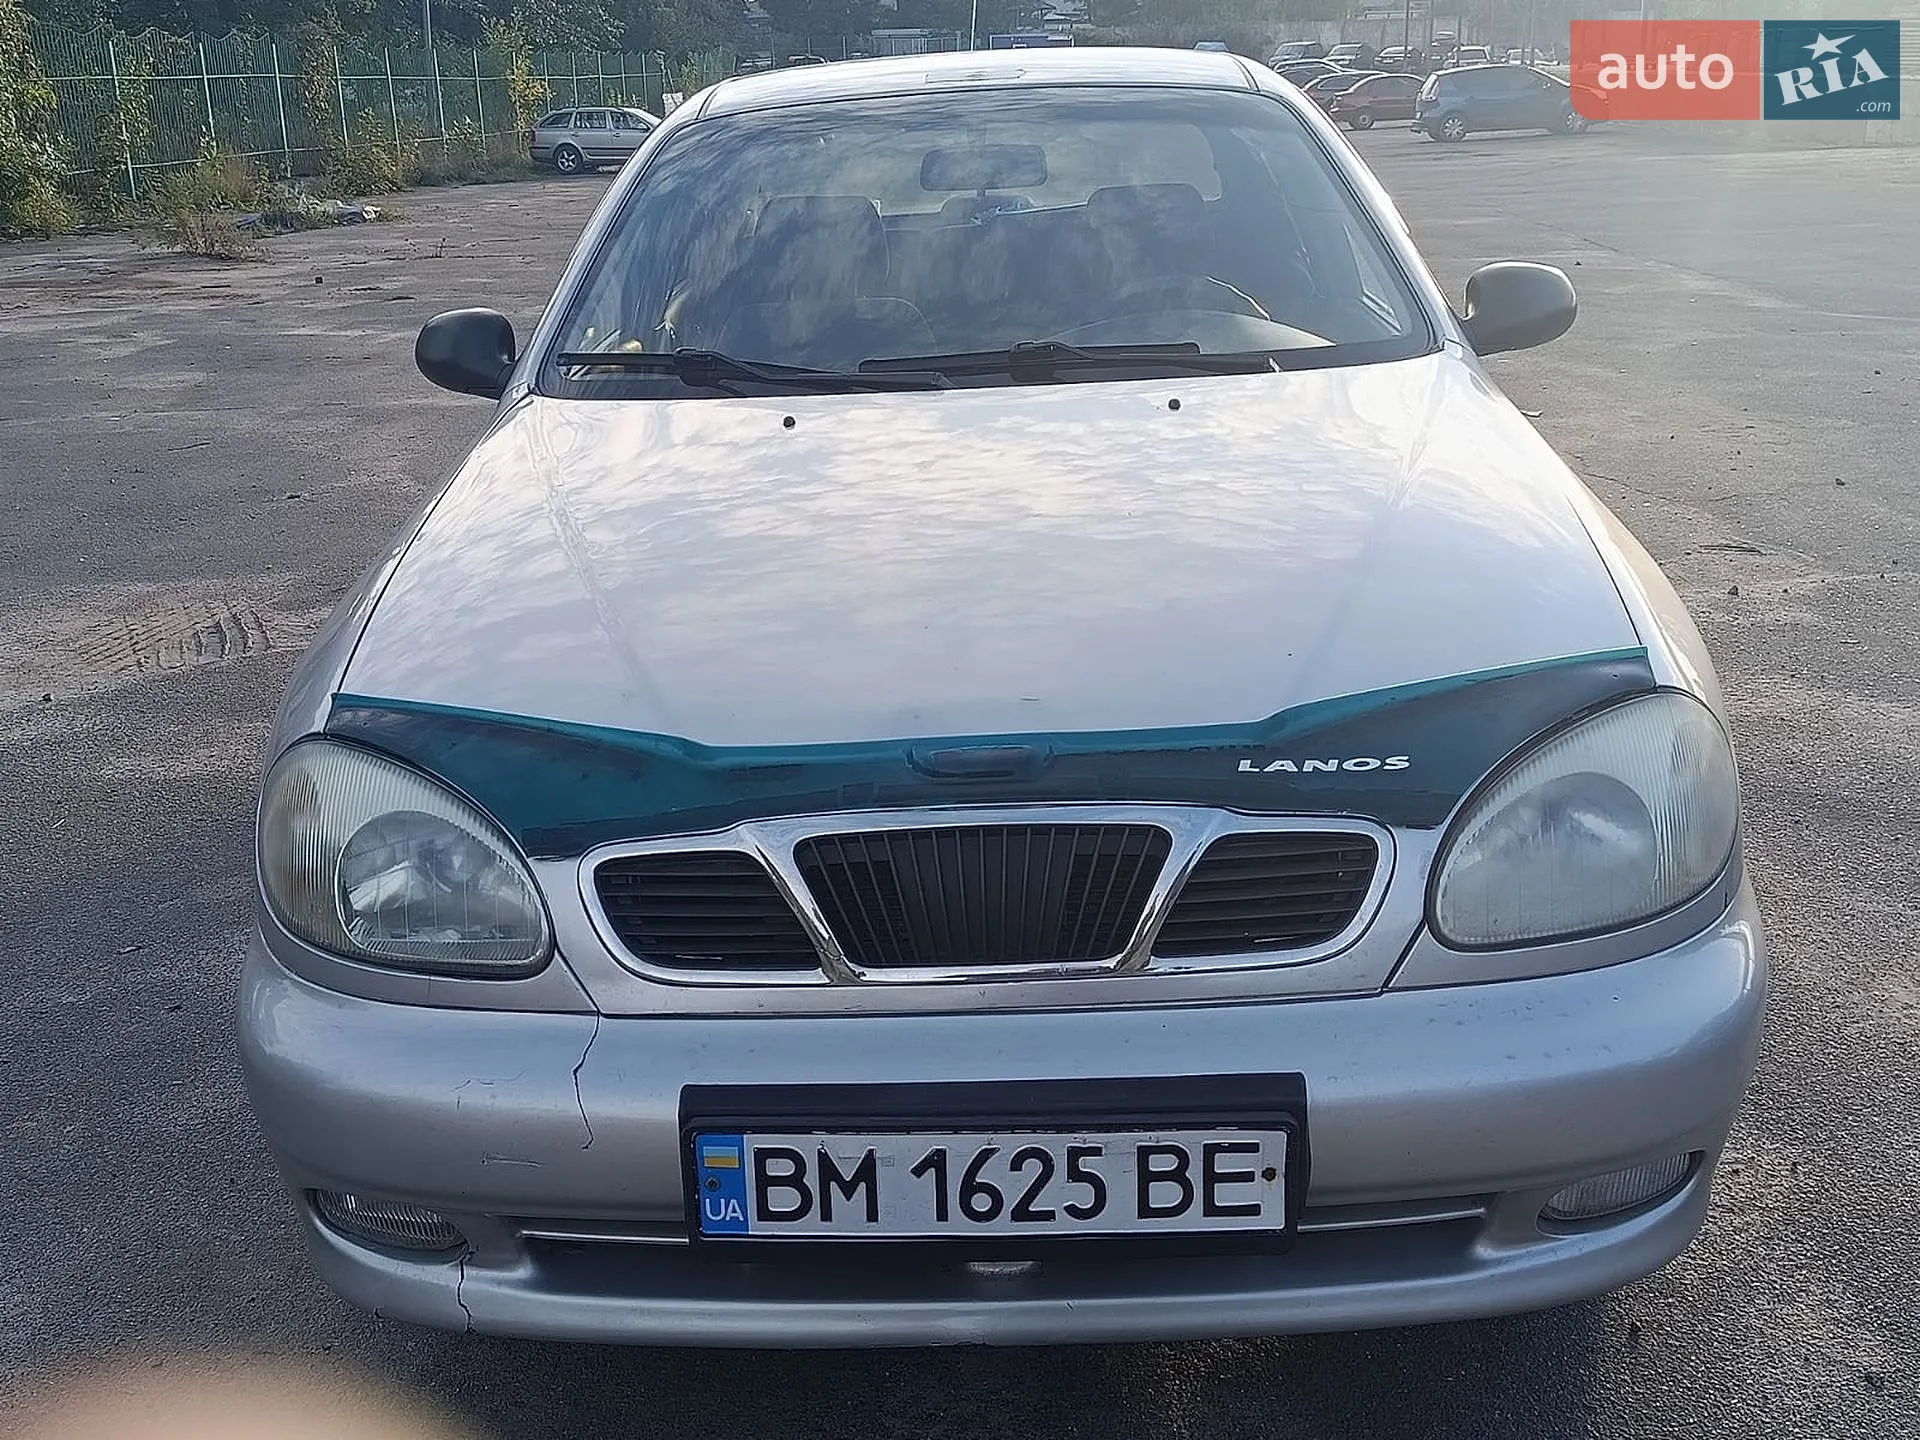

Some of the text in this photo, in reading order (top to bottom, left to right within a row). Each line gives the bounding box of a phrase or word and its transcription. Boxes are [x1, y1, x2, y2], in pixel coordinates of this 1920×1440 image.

[1237, 755, 1411, 773] LANOS
[754, 1142, 1262, 1224] BM 1625 BE
[705, 1198, 745, 1222] UA
